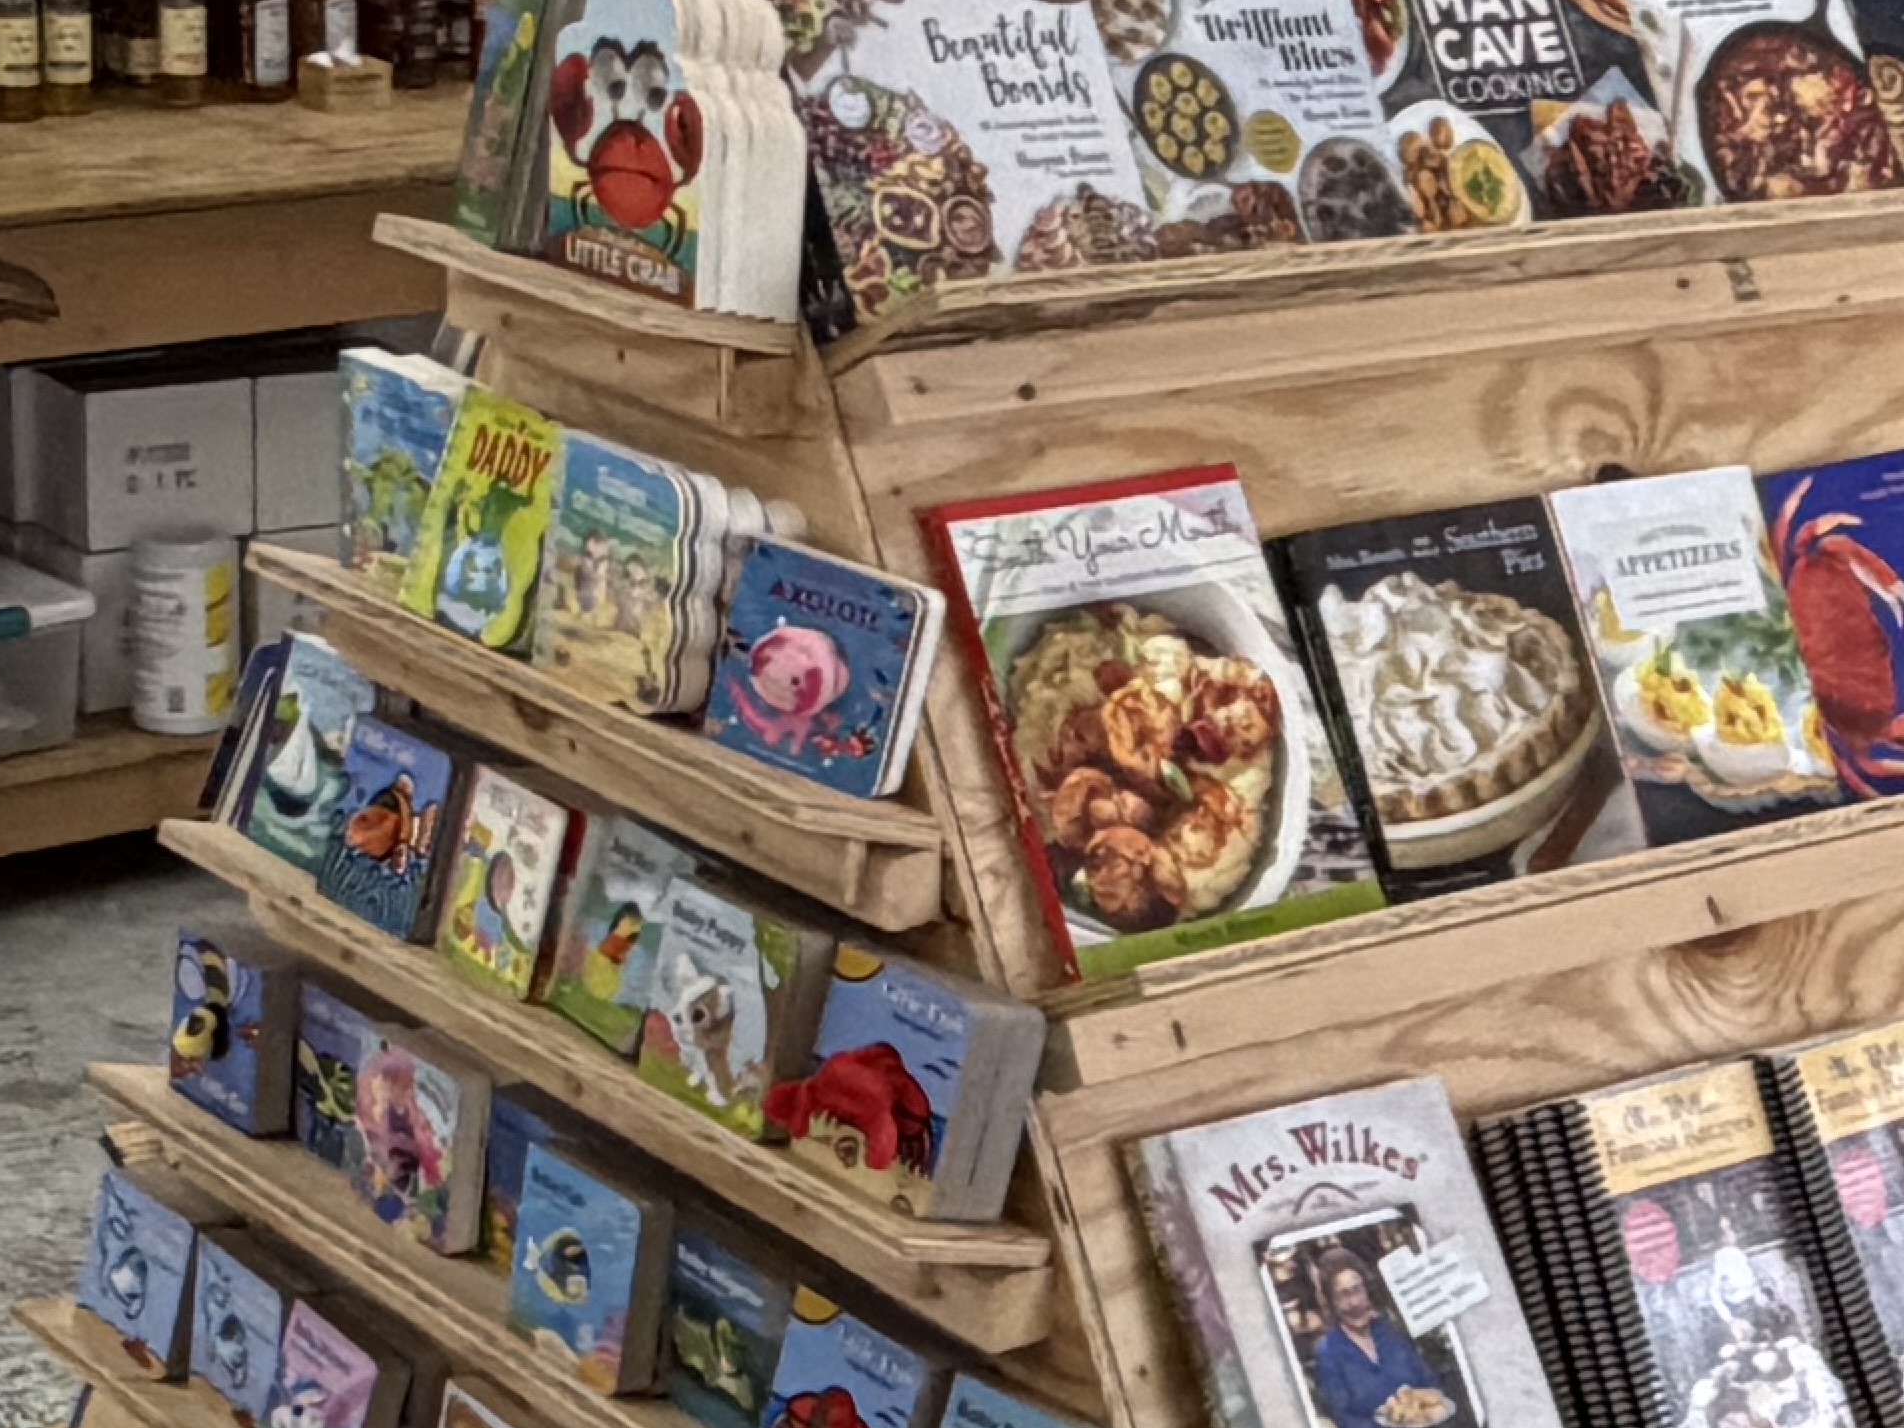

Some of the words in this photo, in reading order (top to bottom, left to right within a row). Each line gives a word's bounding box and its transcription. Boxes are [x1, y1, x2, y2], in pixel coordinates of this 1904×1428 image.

[922, 8, 1080, 70] Beautiful
[1197, 8, 1334, 47] Brilliant
[1434, 16, 1565, 71] CAVE
[1278, 42, 1357, 73] Bites
[980, 59, 1093, 109] Boards
[1445, 68, 1578, 105] COOKING
[565, 233, 622, 276] LITTLE
[625, 251, 682, 294] CRAB
[467, 423, 552, 490] DADDY
[1613, 538, 1742, 582] APPETIZERS
[1207, 1155, 1296, 1224] Mrs.
